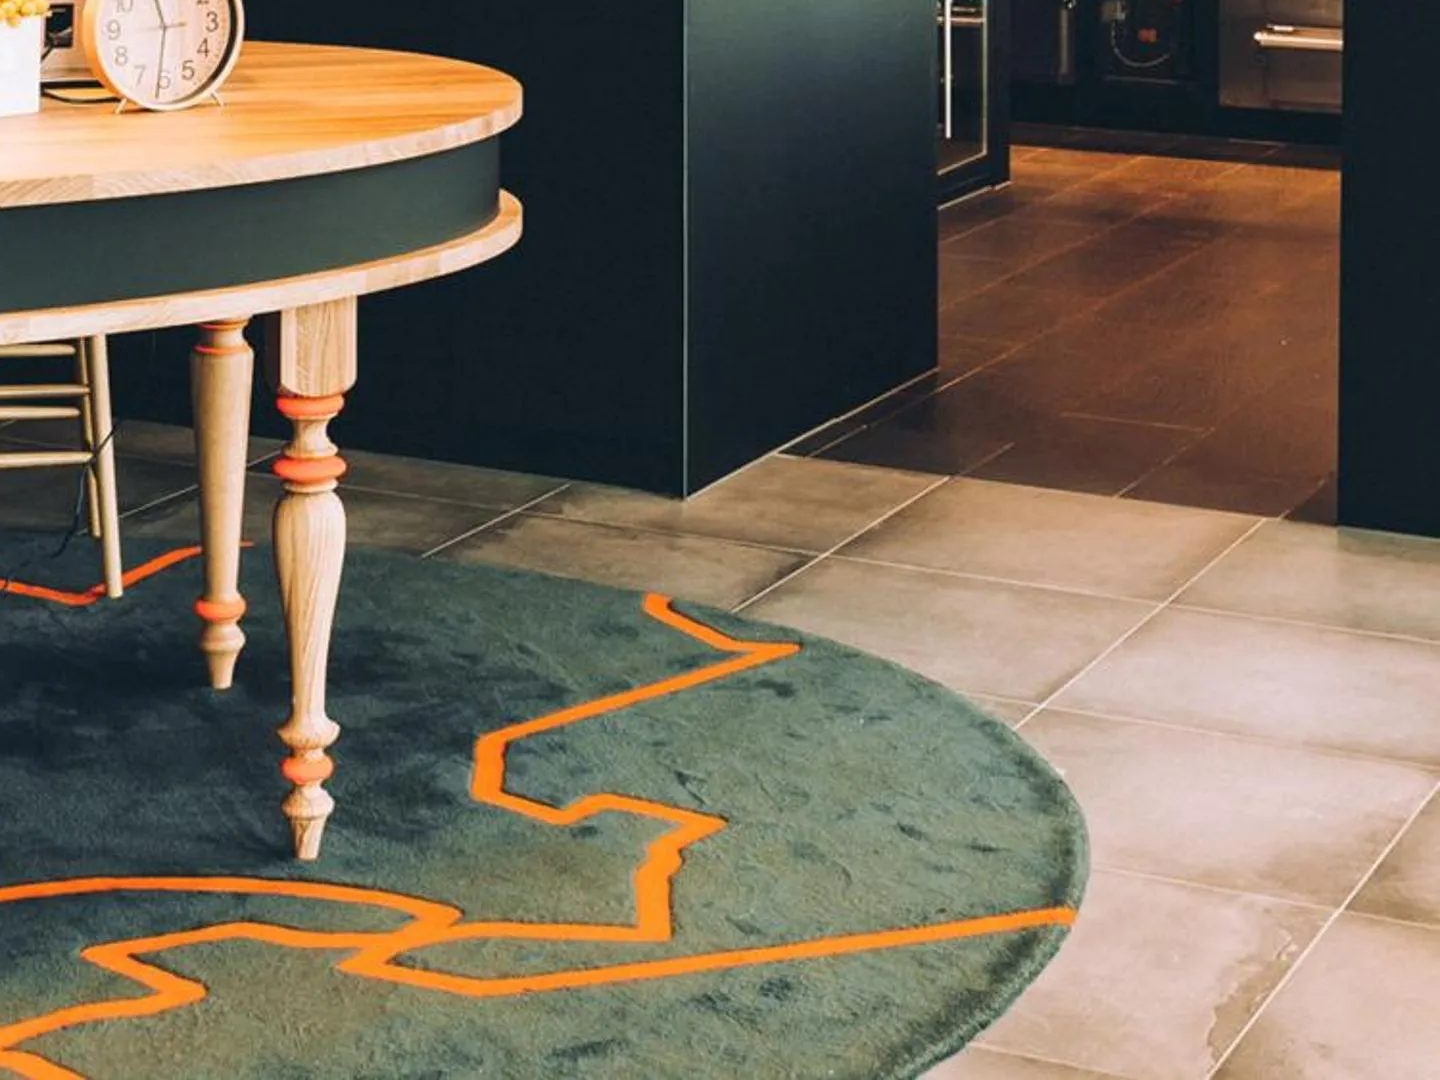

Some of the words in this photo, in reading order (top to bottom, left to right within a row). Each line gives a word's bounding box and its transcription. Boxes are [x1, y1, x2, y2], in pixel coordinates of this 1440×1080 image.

[107, 19, 121, 41] 9
[205, 11, 219, 33] 3
[114, 46, 128, 67] 8
[197, 38, 210, 59] 4
[134, 64, 147, 86] 7
[181, 60, 195, 81] 5
